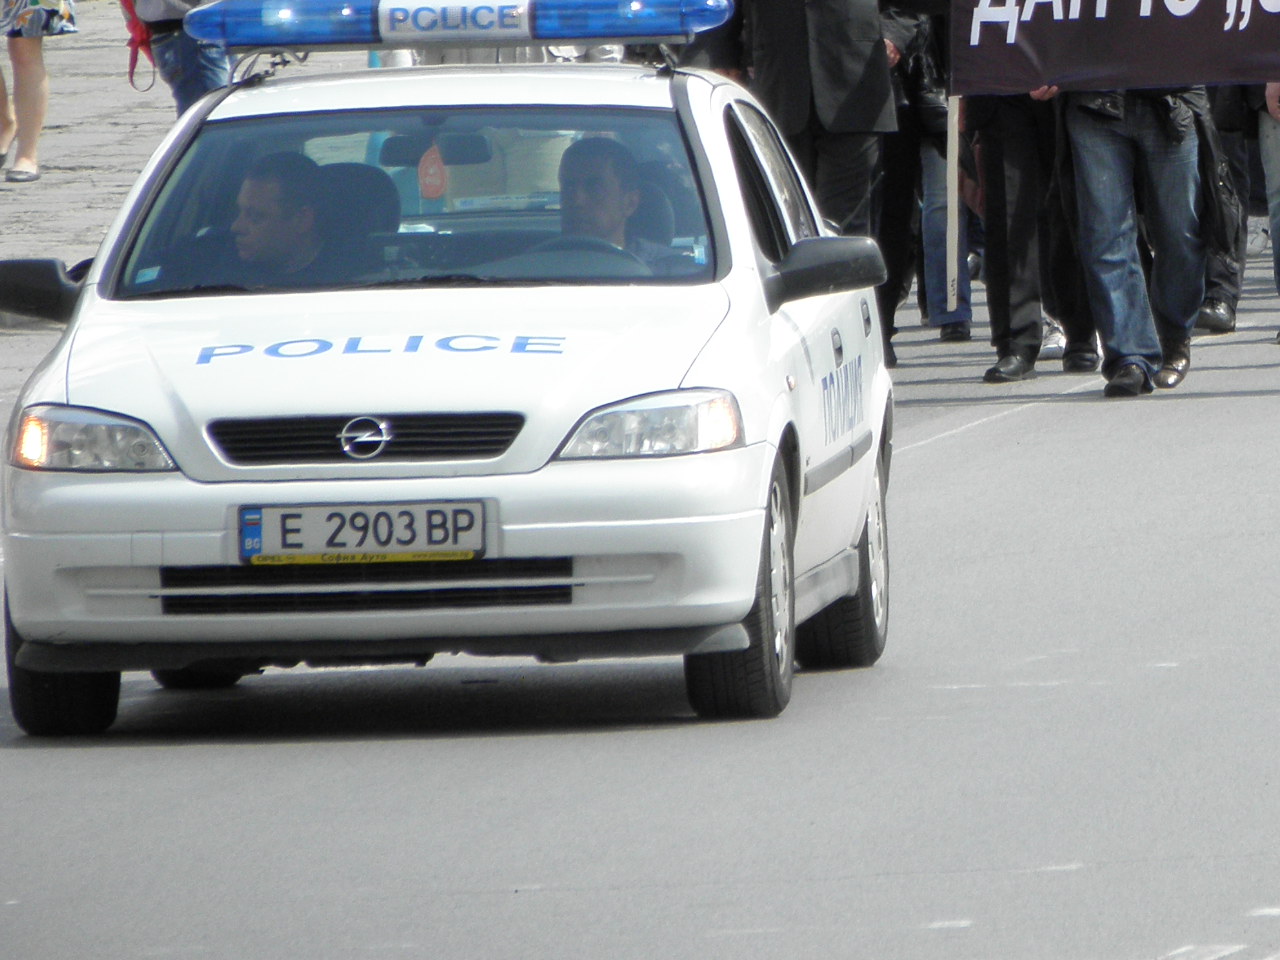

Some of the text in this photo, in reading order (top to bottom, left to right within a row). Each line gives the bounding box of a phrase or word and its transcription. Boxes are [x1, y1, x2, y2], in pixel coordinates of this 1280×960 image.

[388, 5, 520, 32] POLICE
[196, 334, 567, 365] POLICE
[244, 537, 260, 550] BG
[325, 510, 417, 548] 2903
